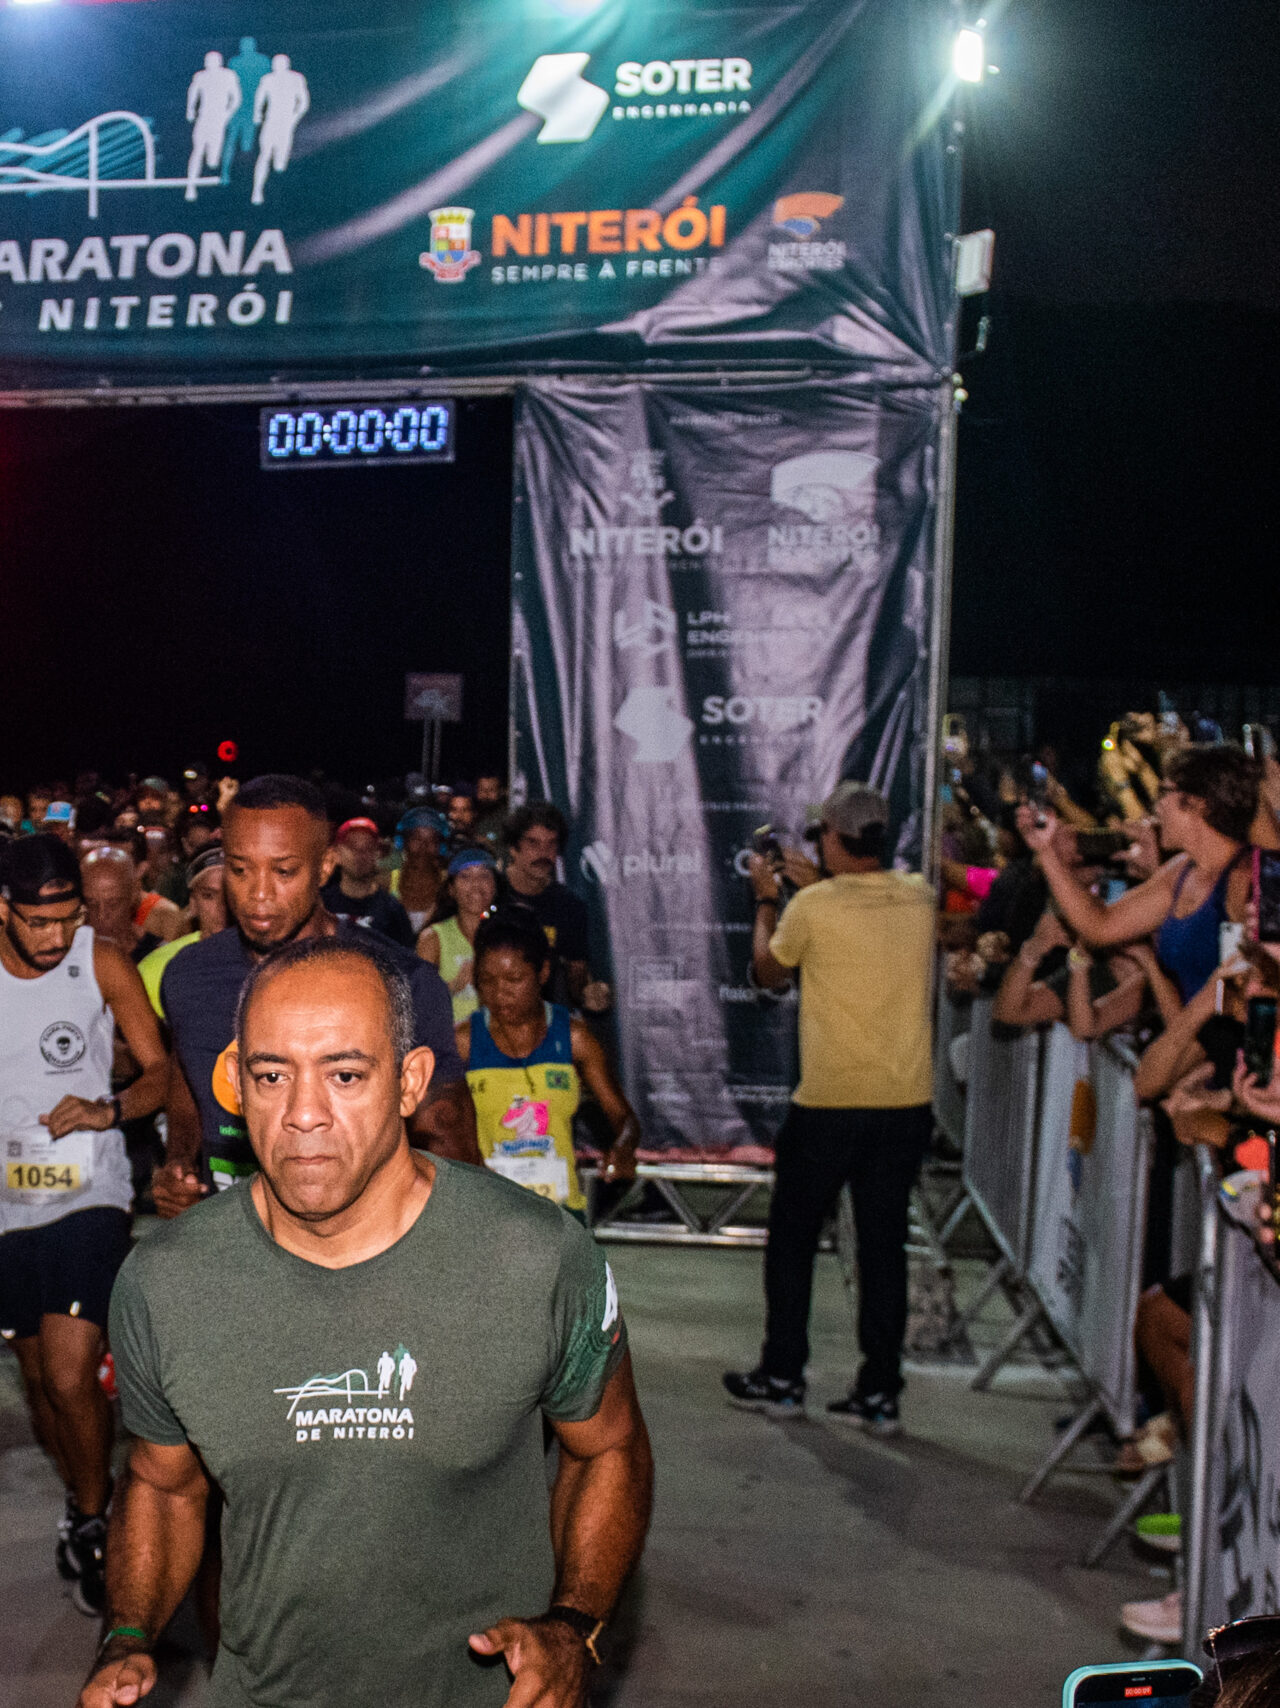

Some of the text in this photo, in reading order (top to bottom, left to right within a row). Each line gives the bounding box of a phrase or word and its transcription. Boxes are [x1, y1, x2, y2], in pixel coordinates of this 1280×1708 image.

[614, 57, 752, 97] SOTER
[612, 100, 751, 120] ENGENHARIA
[491, 195, 727, 257] NITERÓI
[767, 239, 847, 258] NITERÓI
[491, 262, 589, 285] SEMPRE
[38, 283, 293, 332] NITERÓI
[269, 406, 448, 457] 00:00:00
[569, 517, 724, 556] NITERÓI
[702, 694, 823, 724] SOTER
[13, 1165, 73, 1188] 1054
[295, 1407, 414, 1427] MARATONA
[296, 1424, 414, 1443] DE NITERÓI
